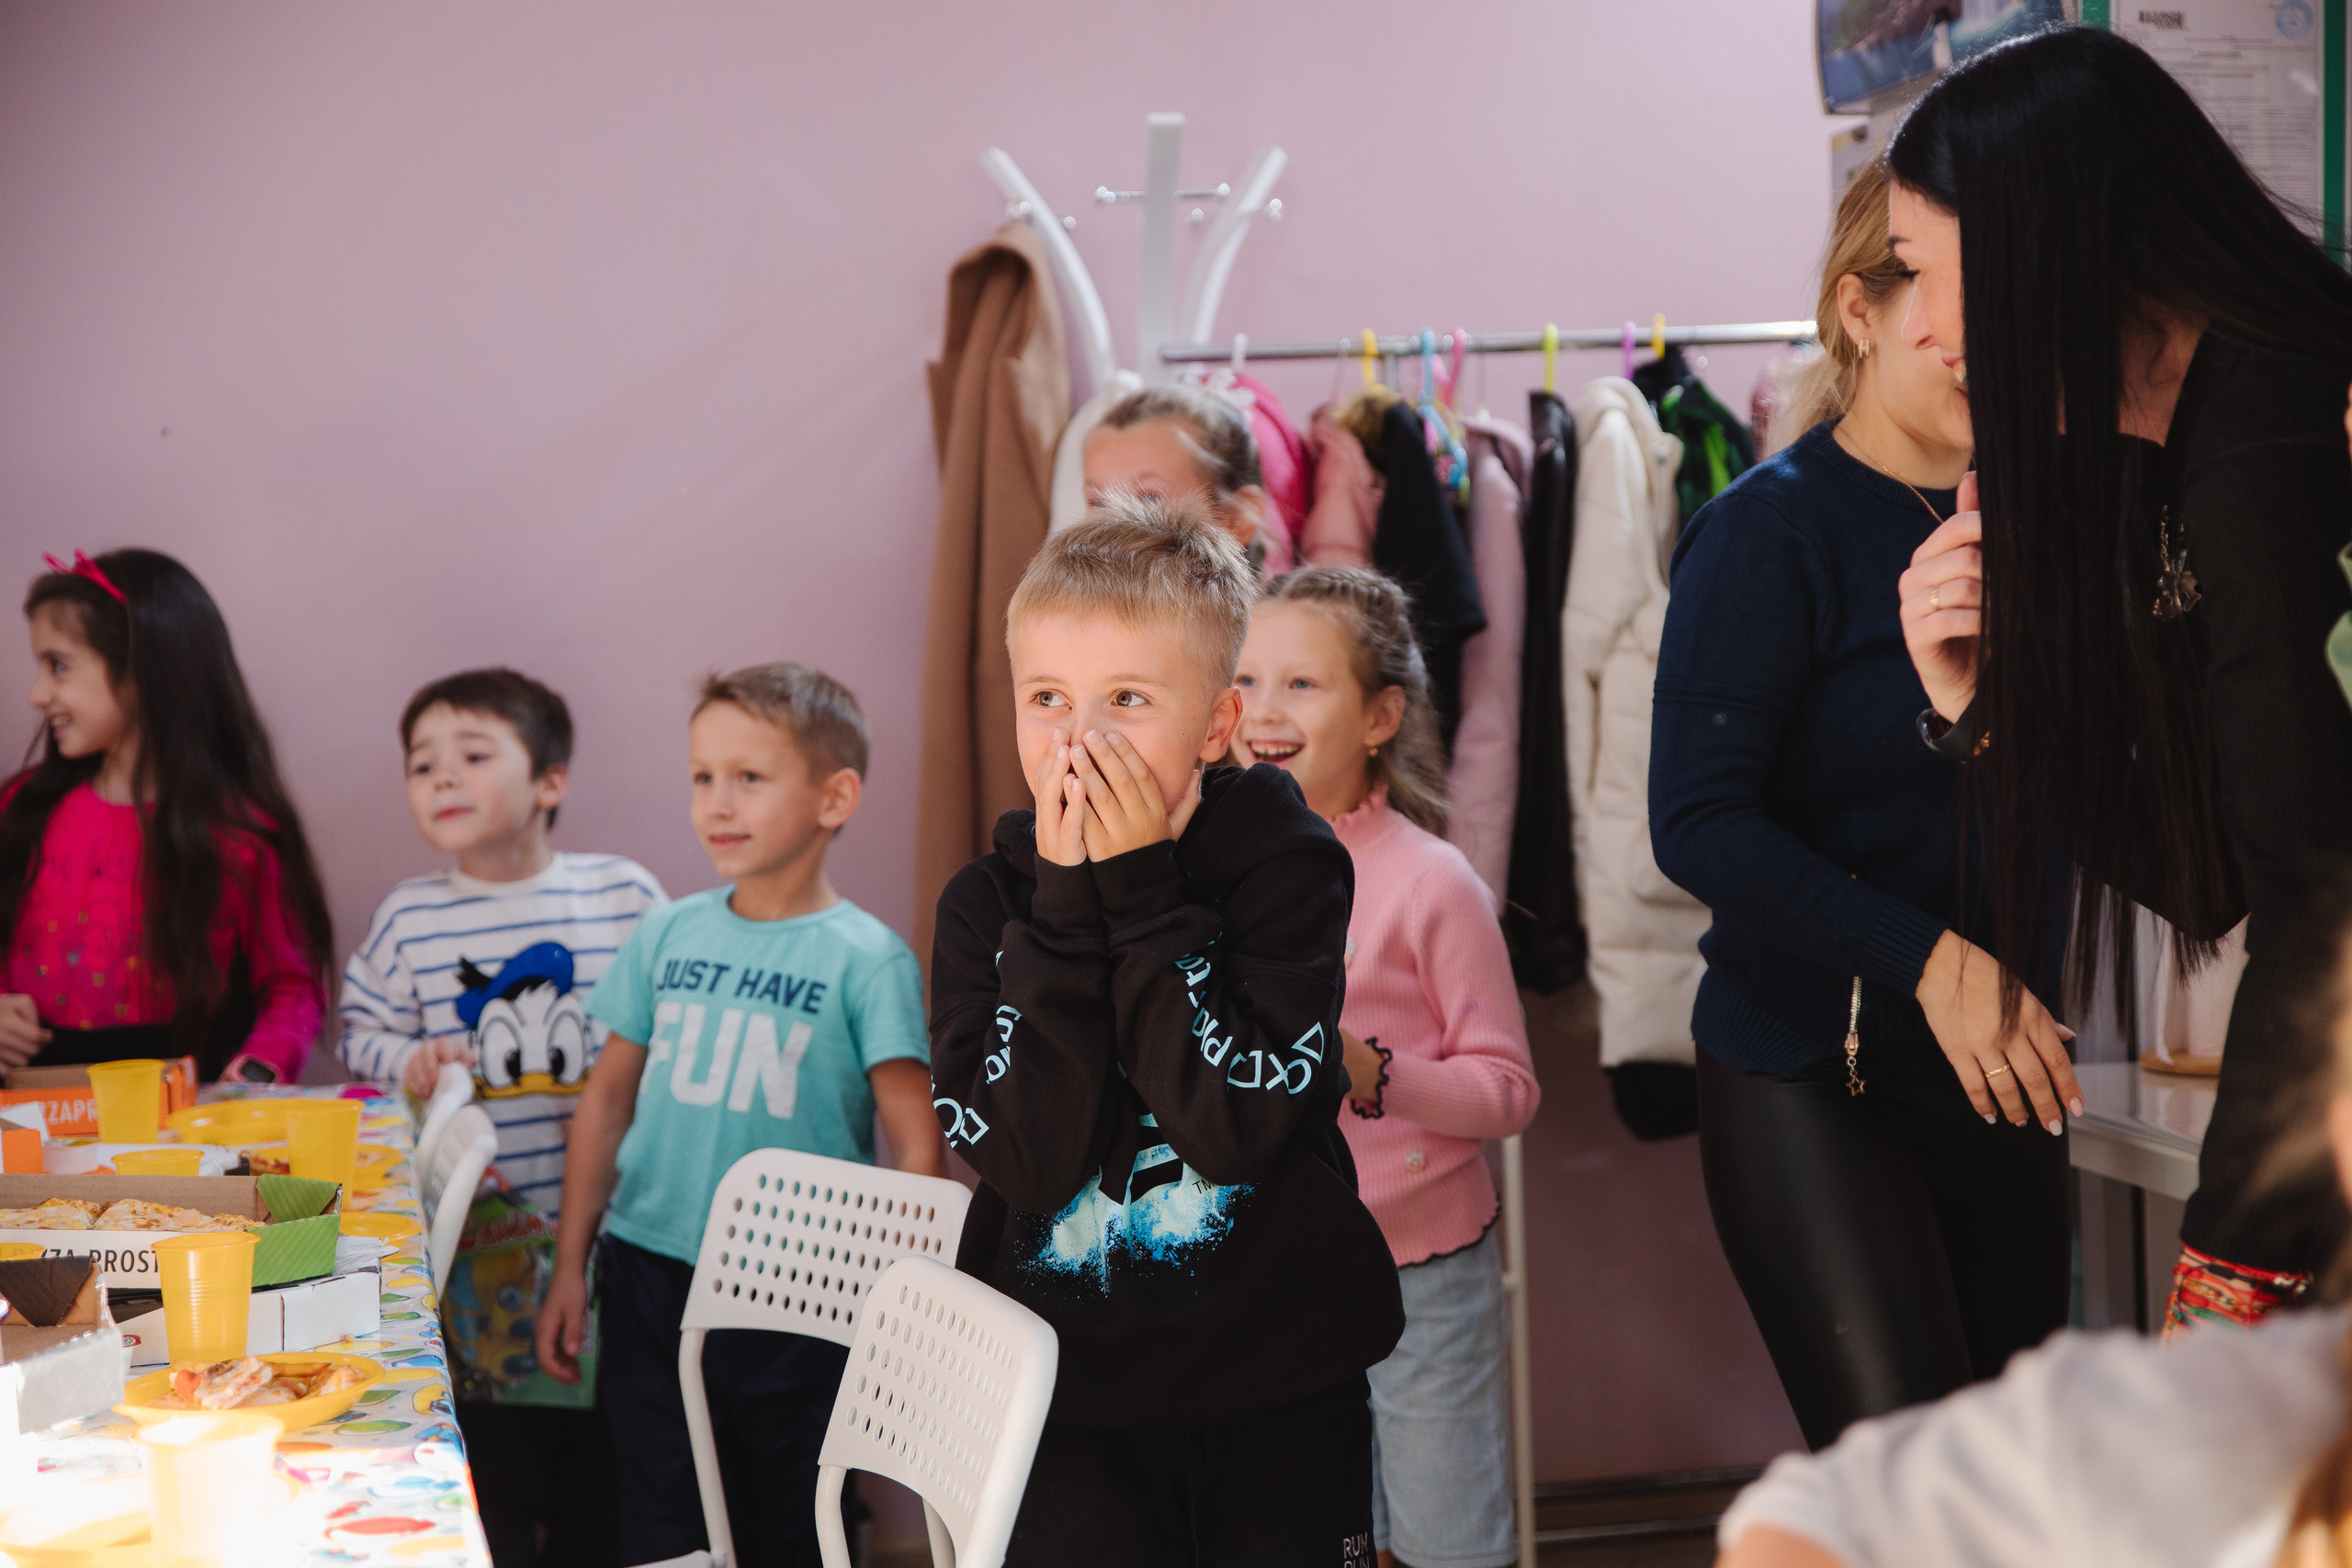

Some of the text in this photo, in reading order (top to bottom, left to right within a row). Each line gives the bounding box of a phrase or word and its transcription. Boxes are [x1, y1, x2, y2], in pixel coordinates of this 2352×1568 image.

[657, 957, 827, 1015] JUST HAVE
[639, 1000, 814, 1121] FUN
[1342, 1531, 1368, 1559] RUN
